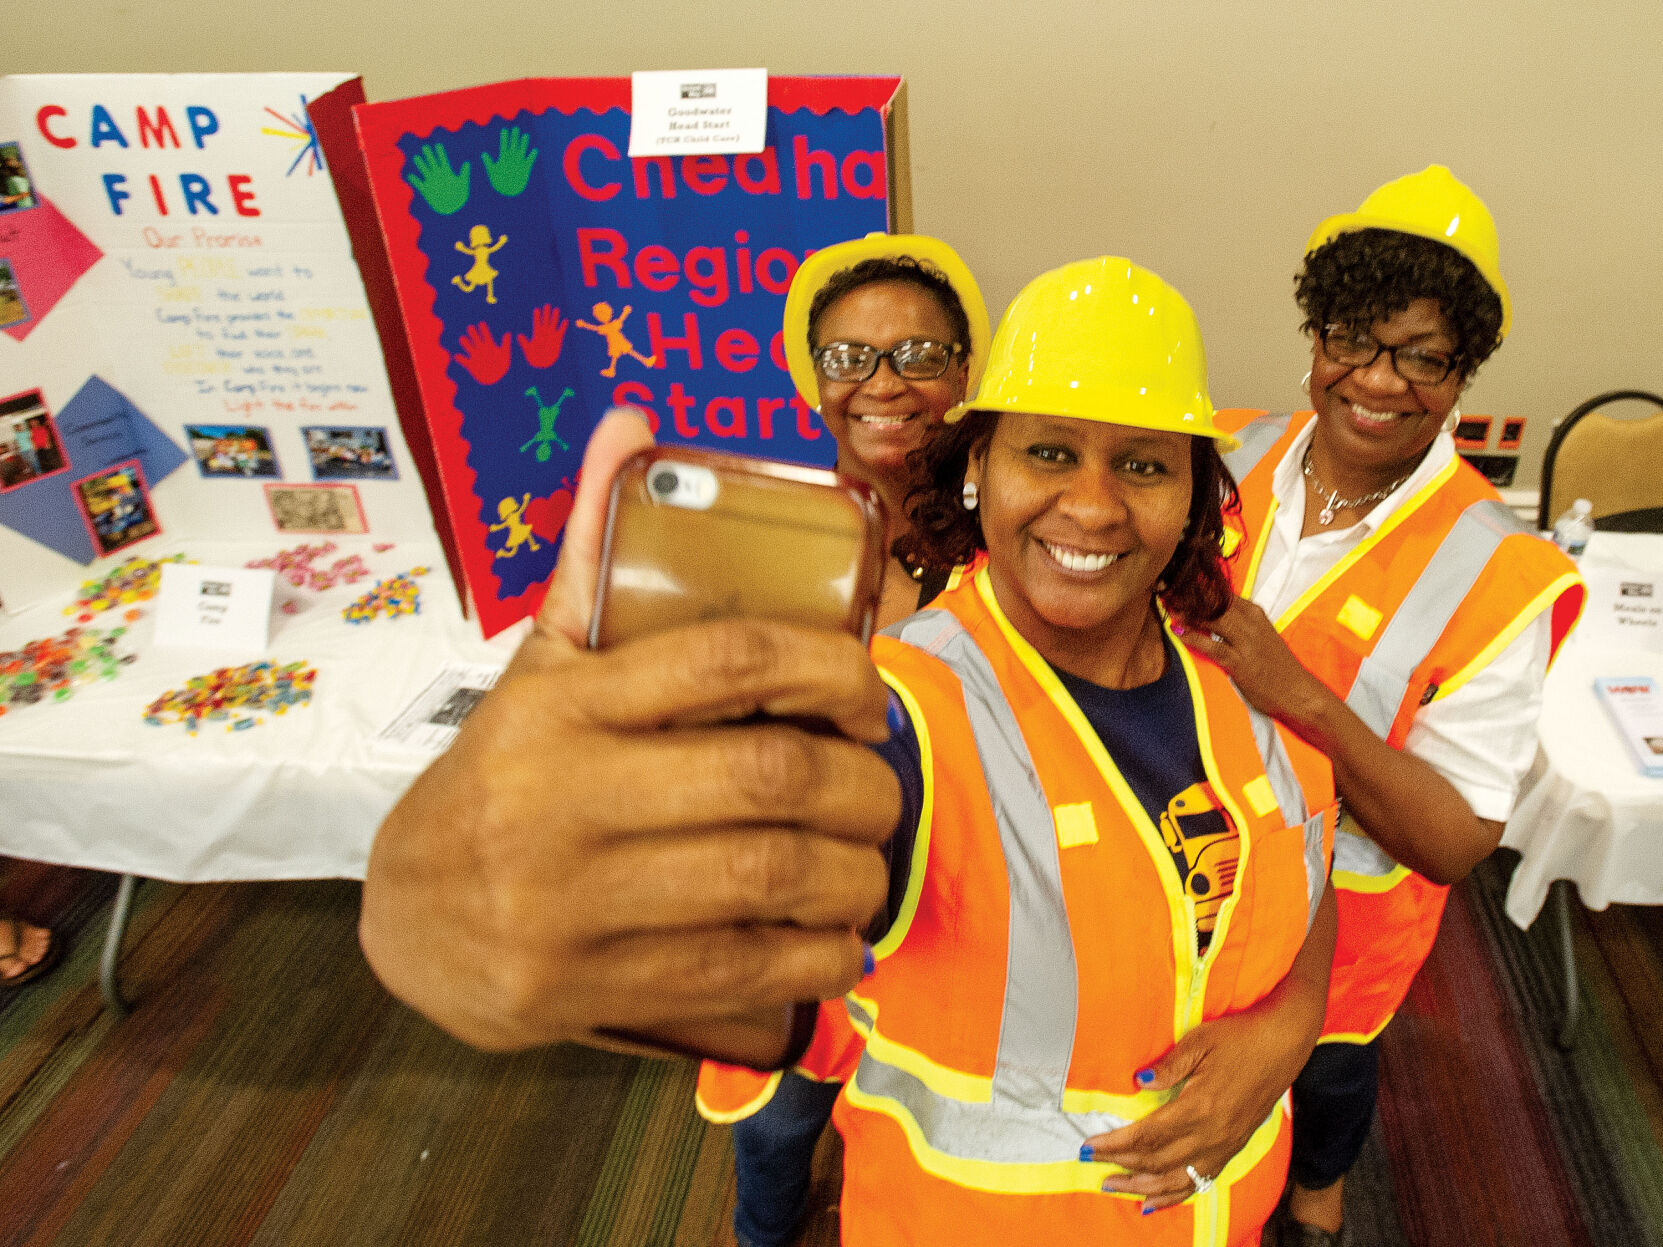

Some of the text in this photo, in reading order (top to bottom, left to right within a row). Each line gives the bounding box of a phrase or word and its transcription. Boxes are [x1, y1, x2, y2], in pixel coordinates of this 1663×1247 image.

[36, 104, 219, 149] CAMP
[102, 173, 261, 217] FIRE
[577, 228, 819, 307] Regio
[612, 381, 821, 440] Start
